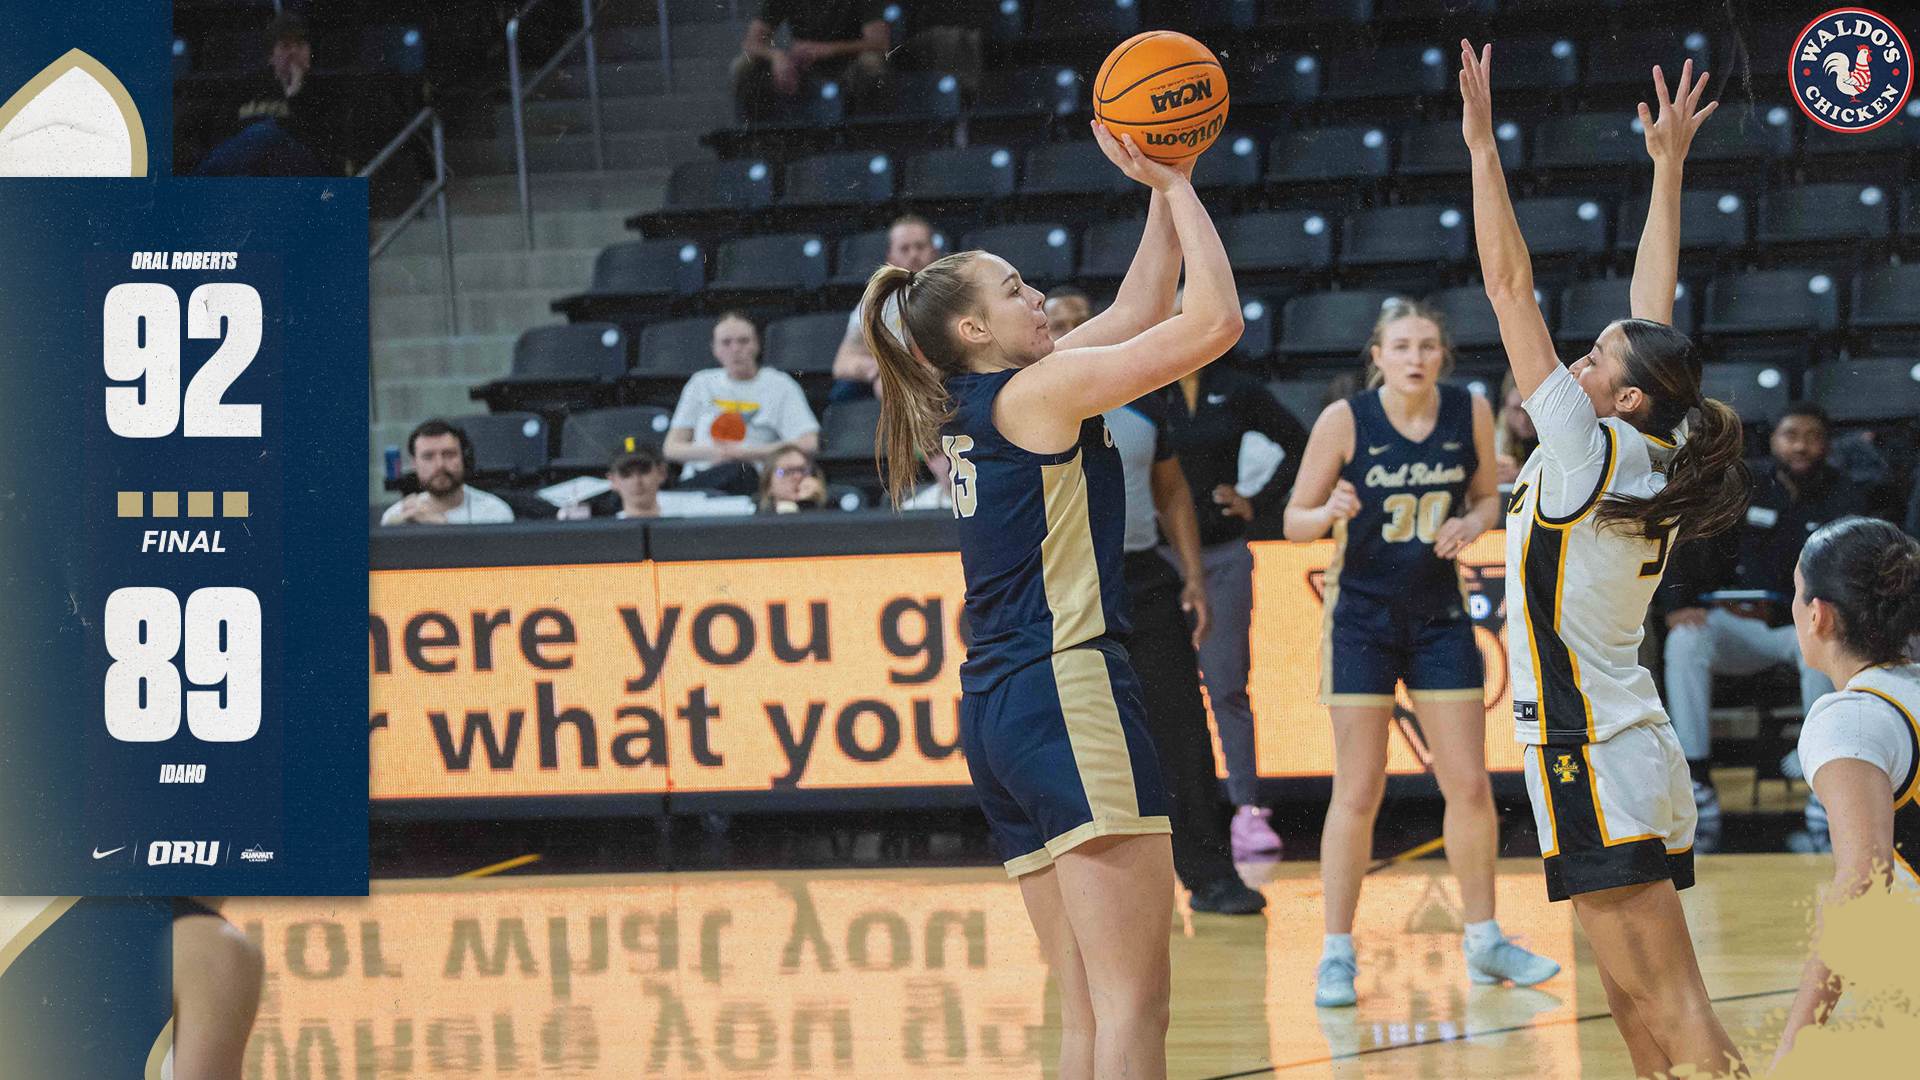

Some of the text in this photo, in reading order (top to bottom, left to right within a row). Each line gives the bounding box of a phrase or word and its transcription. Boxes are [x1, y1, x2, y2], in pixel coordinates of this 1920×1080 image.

[1150, 78, 1212, 113] NCAA
[1146, 113, 1223, 148] Wilson
[1381, 490, 1453, 544] 30
[618, 600, 832, 693] you
[878, 595, 971, 686] g
[427, 680, 725, 772] what
[762, 696, 964, 790] you
